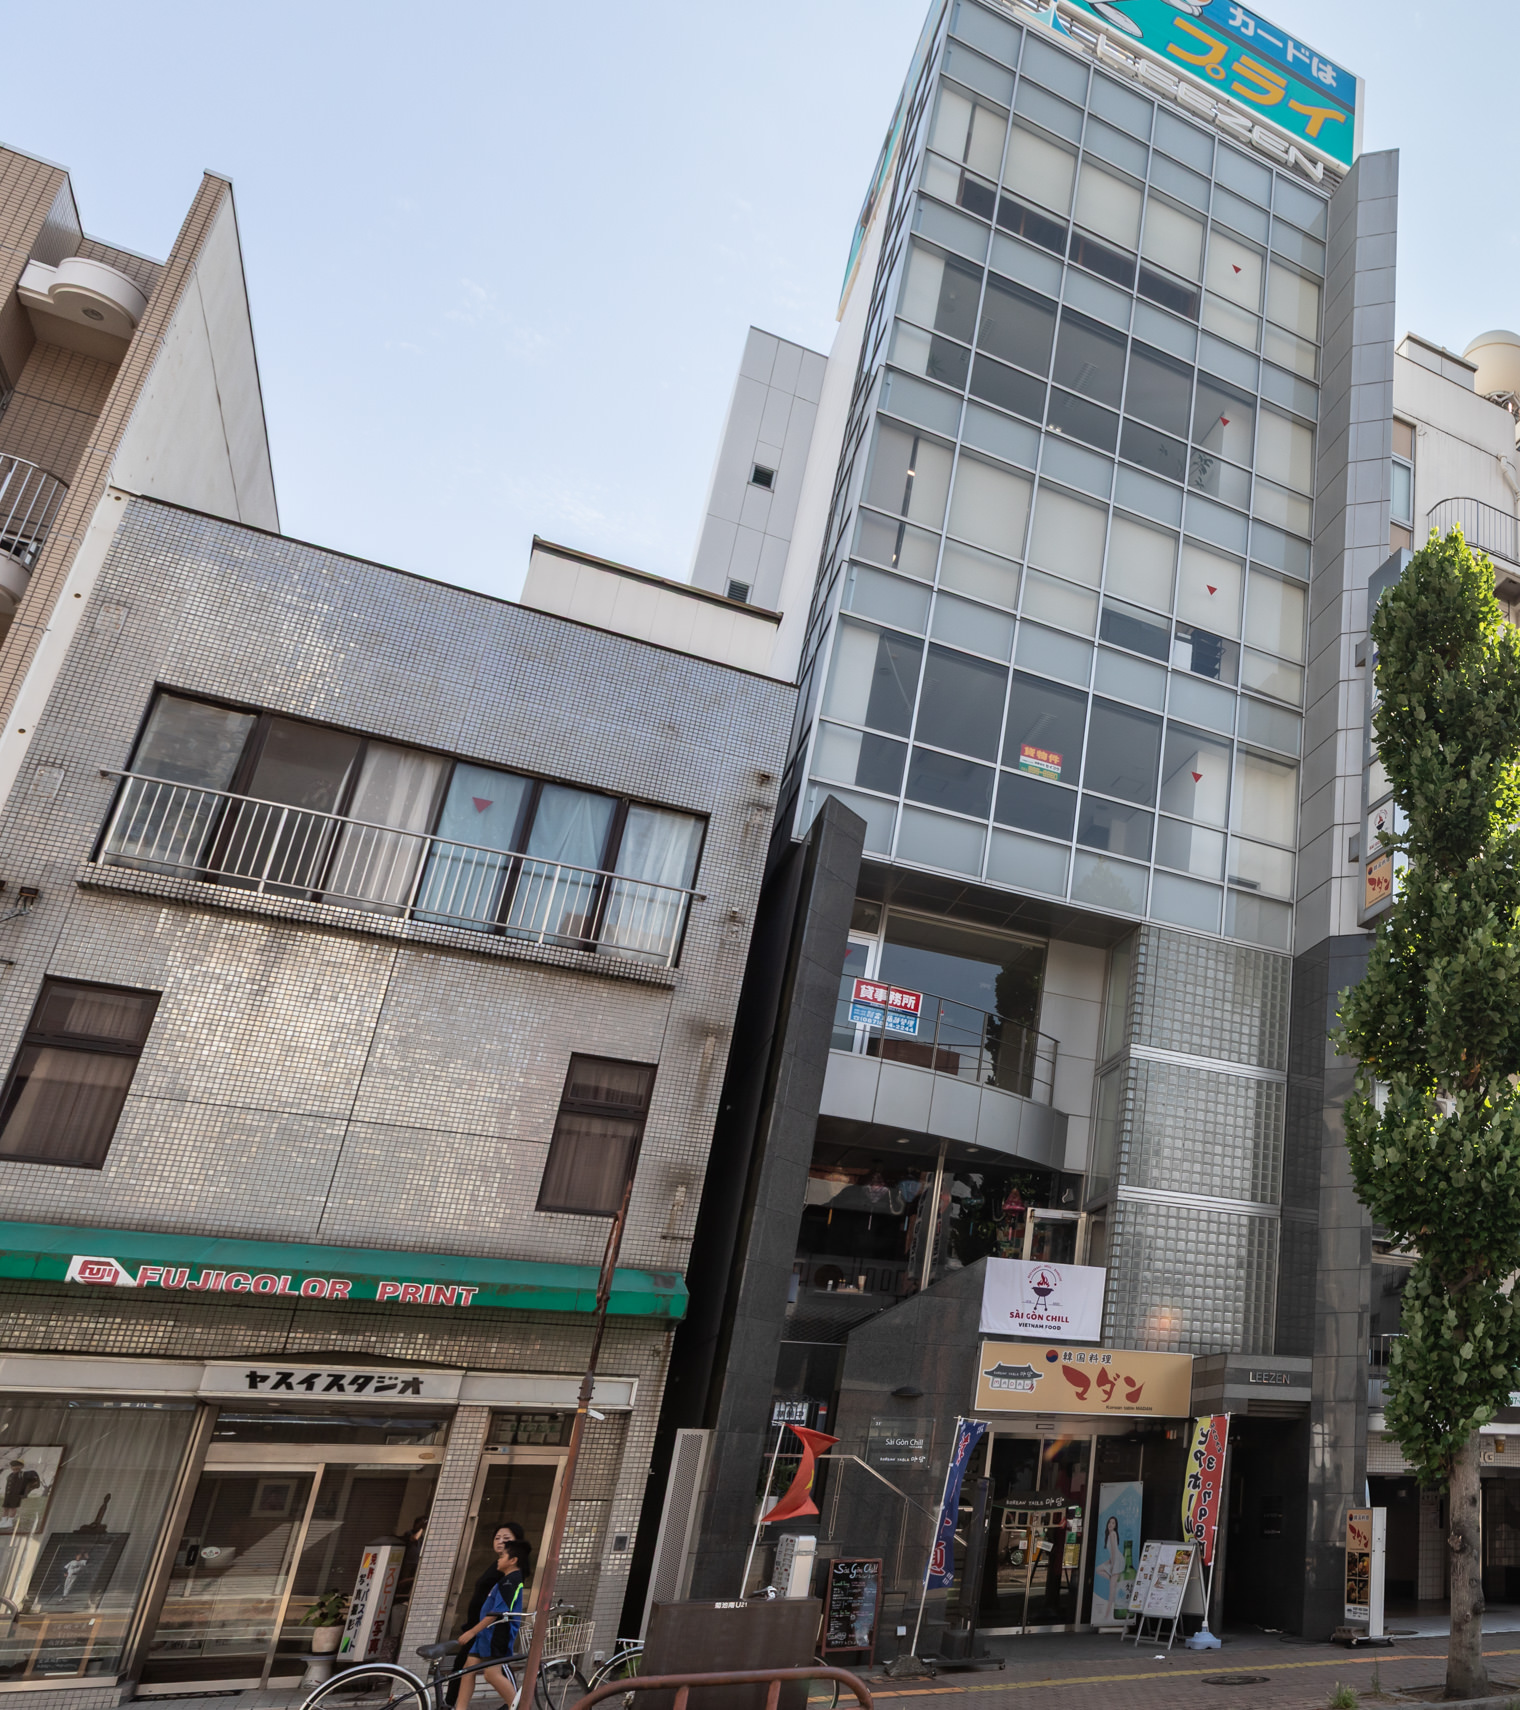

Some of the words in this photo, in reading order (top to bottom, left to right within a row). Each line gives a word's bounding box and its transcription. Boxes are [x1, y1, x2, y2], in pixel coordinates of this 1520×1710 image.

[1228, 5, 1337, 88] カードは
[1166, 16, 1348, 138] プライ
[1097, 32, 1324, 183] LEEZEN
[1368, 876, 1390, 893] マダン
[859, 984, 917, 1010] 貸事務所
[134, 1264, 352, 1300] FUJICOLOR
[375, 1281, 479, 1306] PRINT
[1009, 1309, 1024, 1319] SÀI
[1026, 1310, 1044, 1321] GÒN
[1045, 1314, 1070, 1323] CHILL
[1062, 1351, 1112, 1365] 韓国料理
[244, 1370, 425, 1396] ヤスイスタジオ
[1061, 1364, 1145, 1404] マダン
[1249, 1371, 1290, 1385] LEEZEN
[367, 1567, 397, 1656] スピード写真
